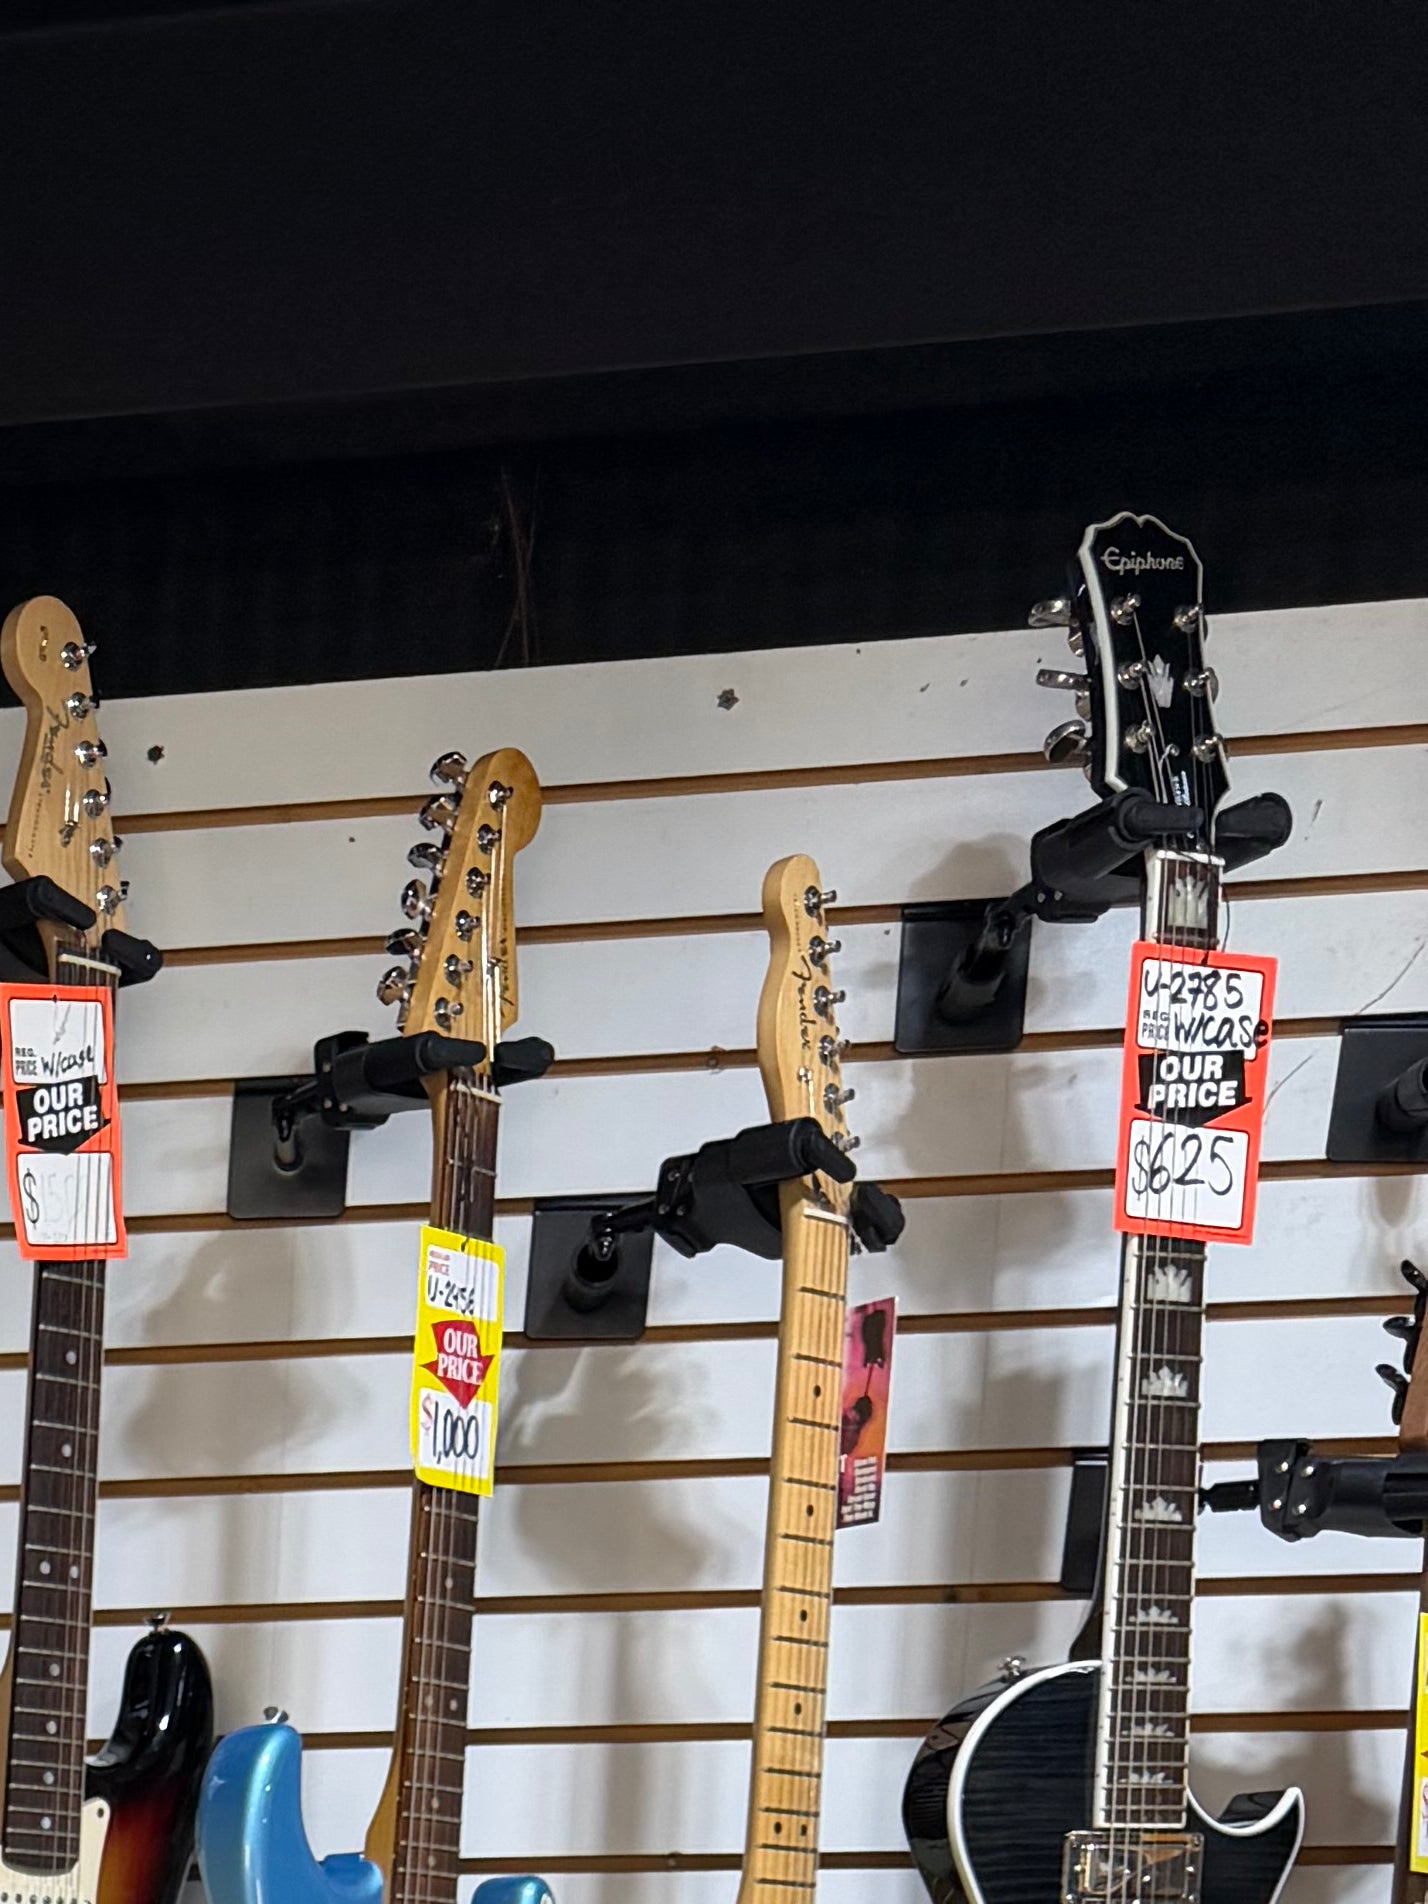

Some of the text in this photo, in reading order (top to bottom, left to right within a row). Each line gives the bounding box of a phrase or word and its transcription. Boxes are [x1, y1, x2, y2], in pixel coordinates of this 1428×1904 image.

[1100, 546, 1184, 576] Epiphone
[39, 699, 71, 795] Fender
[792, 955, 817, 1051] Fender
[1144, 968, 1245, 1013] U-2785
[1141, 1022, 1170, 1042] PRICE
[14, 1060, 38, 1077] PRICE
[1159, 1054, 1224, 1081] OUR
[33, 1083, 84, 1115] OUR
[1147, 1080, 1239, 1110] PRICE
[27, 1106, 99, 1143] PRICE
[1131, 1130, 1236, 1202] $625
[428, 1260, 450, 1277] PRICE
[443, 1328, 478, 1359] OUR
[437, 1354, 483, 1386] PRICE
[420, 1392, 480, 1465] $1,000
